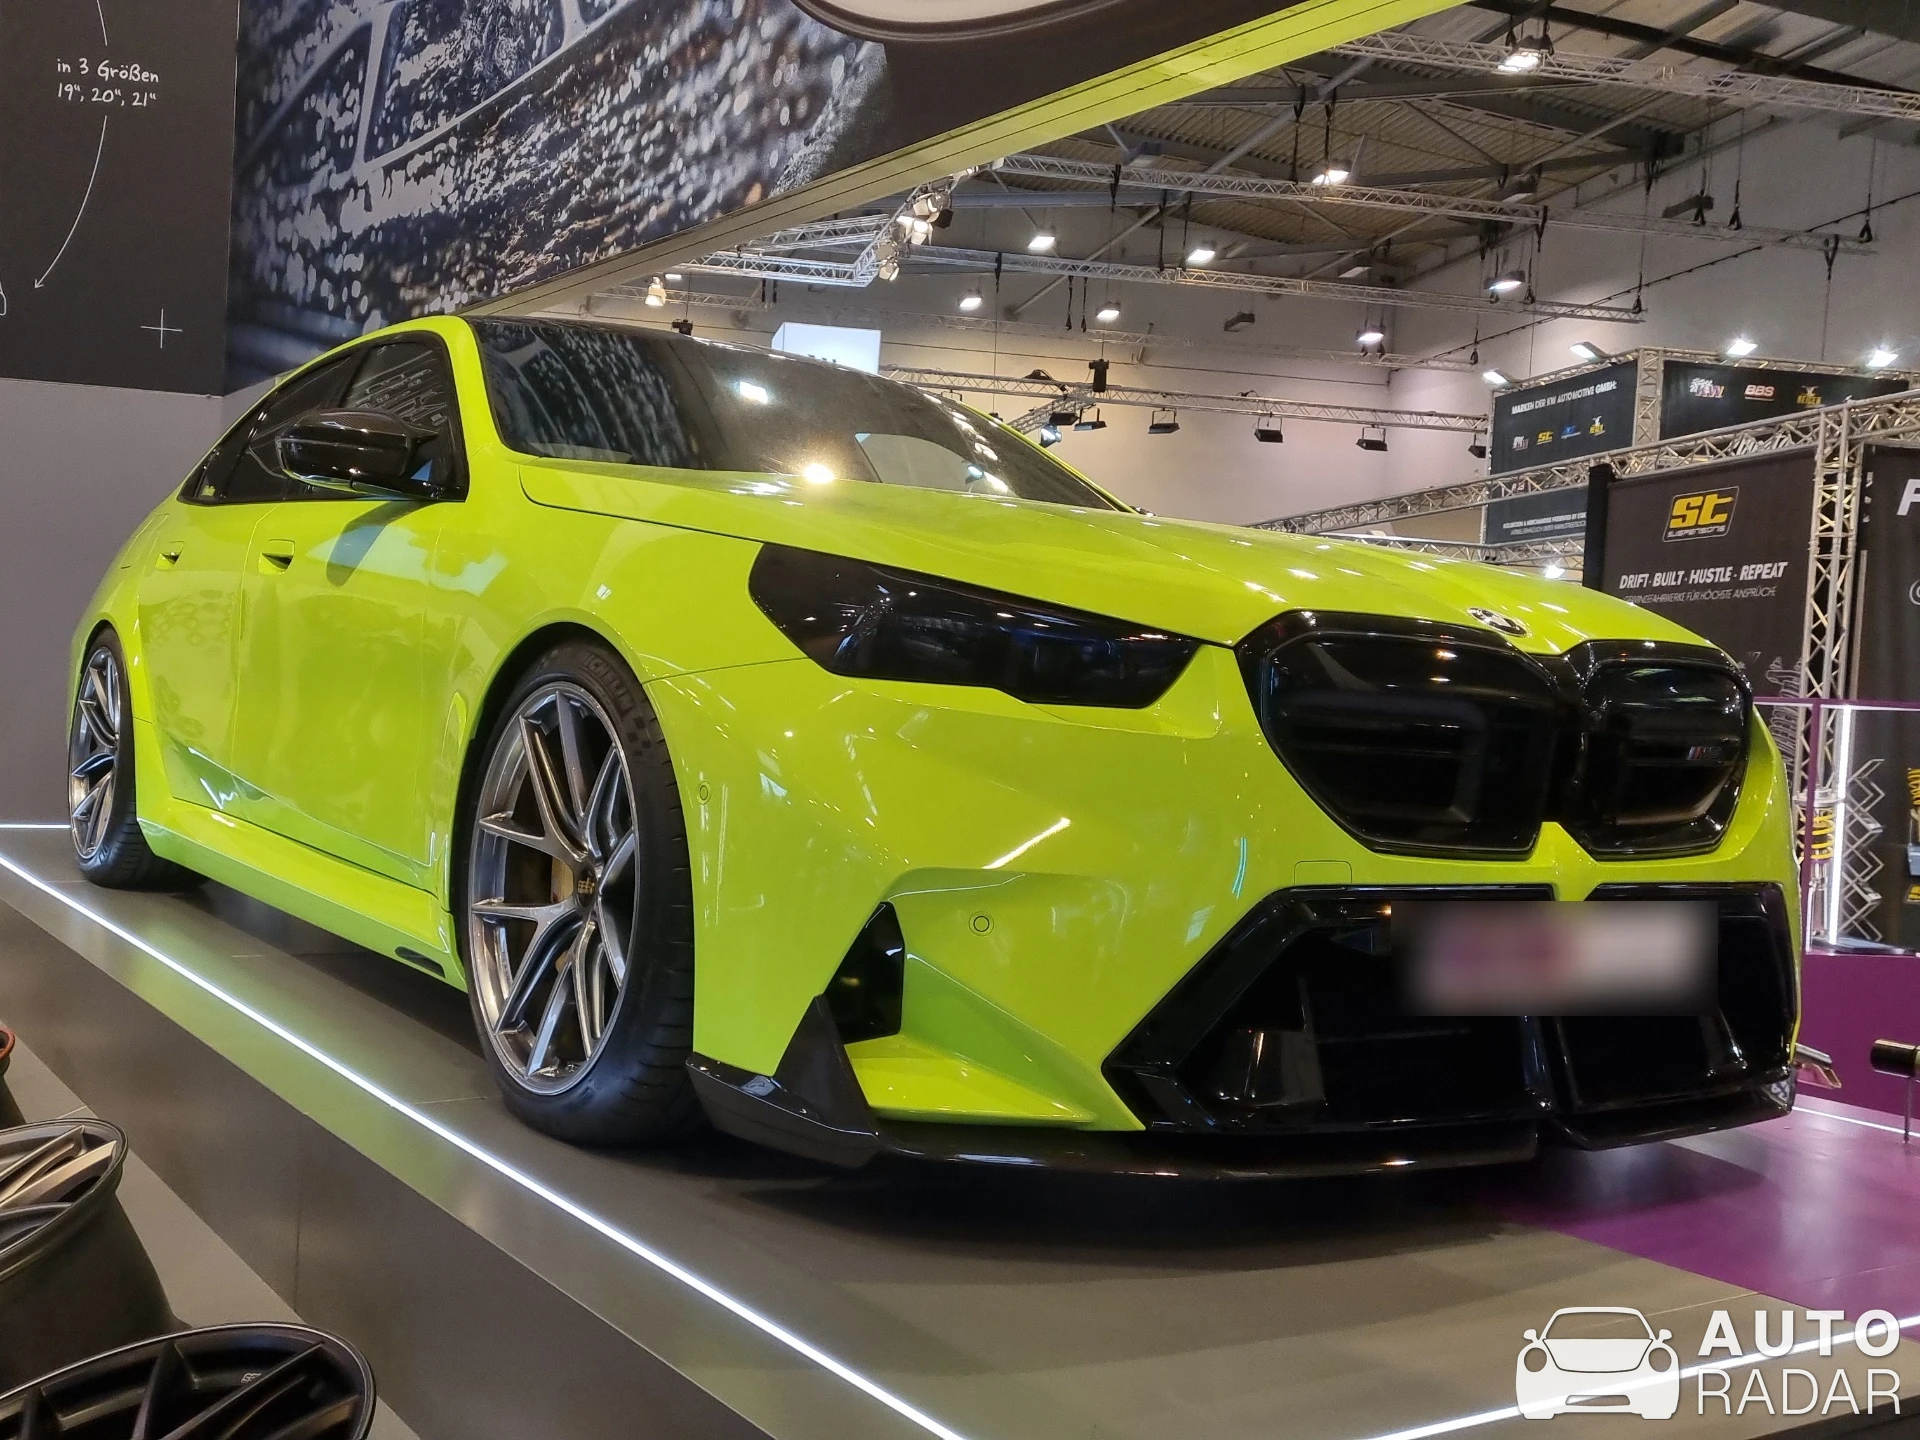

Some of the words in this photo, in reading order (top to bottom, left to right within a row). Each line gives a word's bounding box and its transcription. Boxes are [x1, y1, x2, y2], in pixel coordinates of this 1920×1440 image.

[57, 58, 71, 73] in
[79, 57, 89, 75] 3
[97, 60, 159, 82] Größen
[1511, 402, 1535, 415] MARKEN
[1534, 399, 1546, 410] DER
[1546, 396, 1557, 406] KW
[1557, 385, 1595, 404] AUTOMOTIVE
[1744, 384, 1775, 397] BBS
[1619, 573, 1650, 589] DRIFT
[1652, 570, 1685, 588] BUILT
[1688, 565, 1734, 584] HUSTLE
[1739, 561, 1788, 581] REPEAT
[1734, 585, 1777, 599] ANSPRÜCHE
